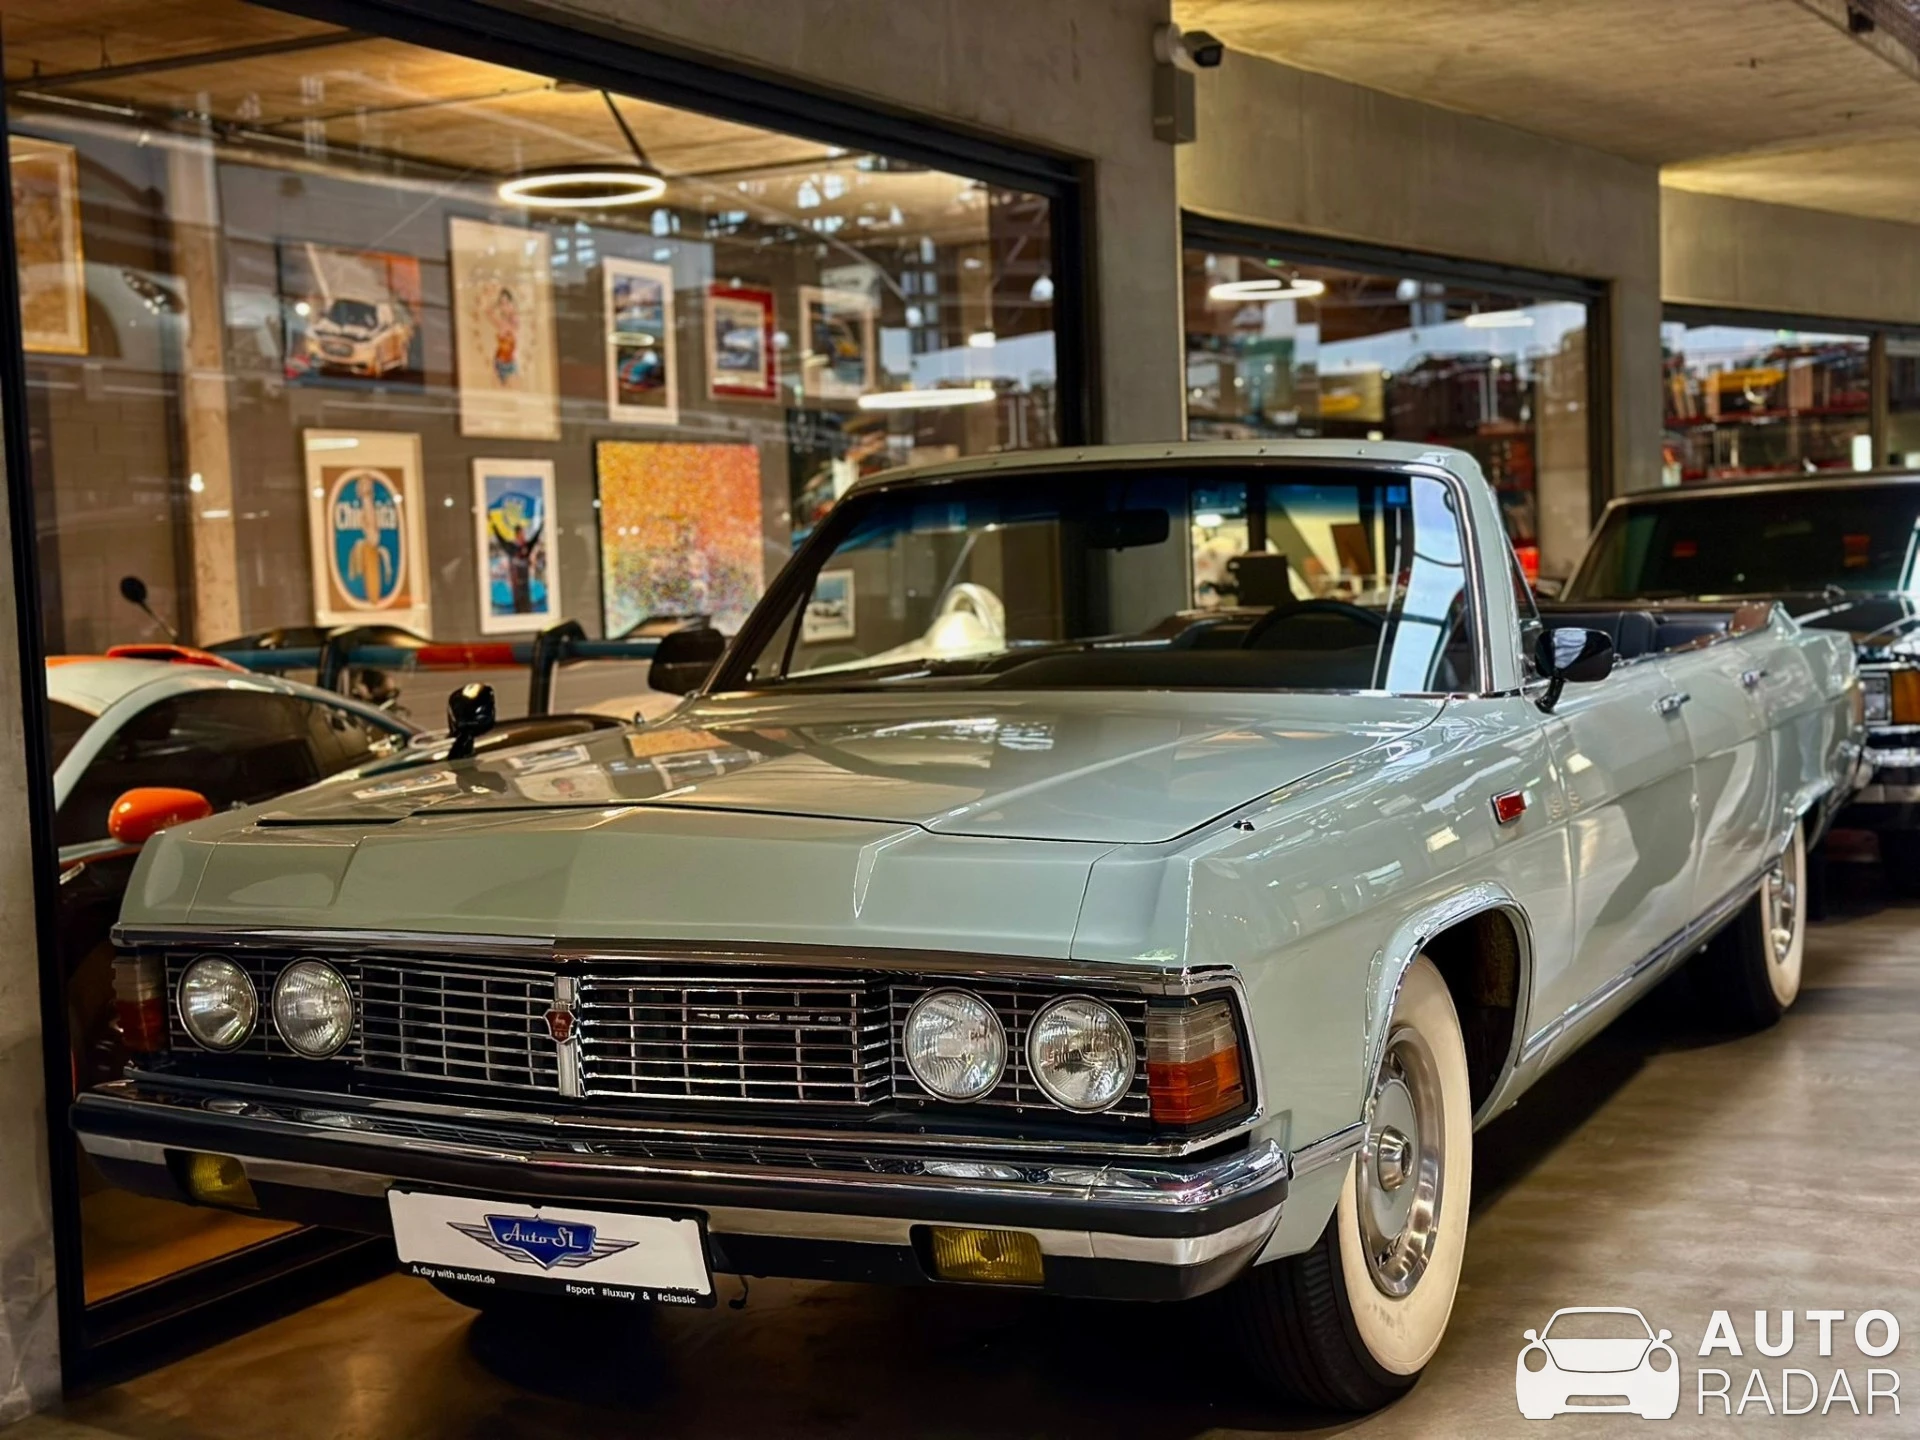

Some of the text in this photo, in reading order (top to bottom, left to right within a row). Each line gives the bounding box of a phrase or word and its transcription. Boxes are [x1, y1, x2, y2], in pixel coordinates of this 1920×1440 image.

[412, 1265, 496, 1284] A day with autosl.de
[565, 1284, 697, 1305] #sport #luxury & #classic
